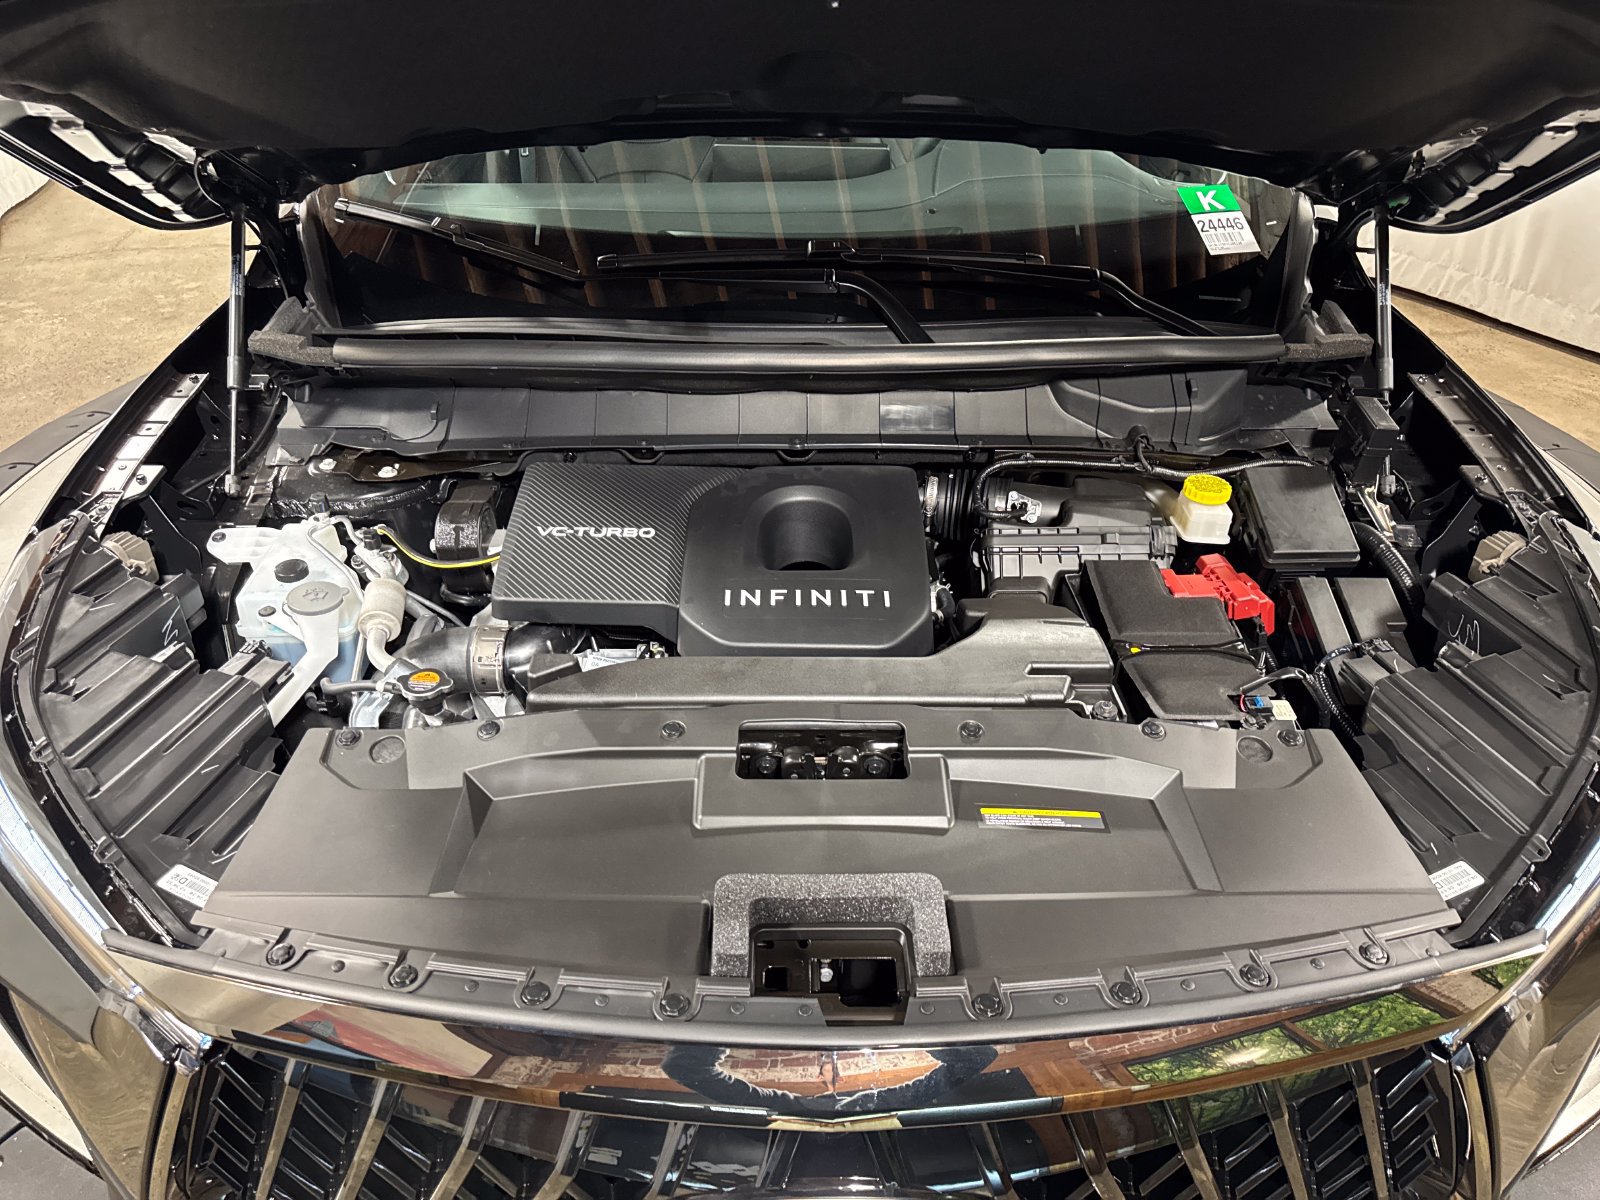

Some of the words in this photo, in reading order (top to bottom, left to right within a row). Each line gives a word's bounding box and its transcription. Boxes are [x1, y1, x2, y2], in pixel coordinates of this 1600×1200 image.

[1196, 190, 1226, 210] K
[1197, 217, 1244, 233] 24446
[536, 526, 656, 538] VC-TURBO
[724, 589, 891, 607] INFINITI
